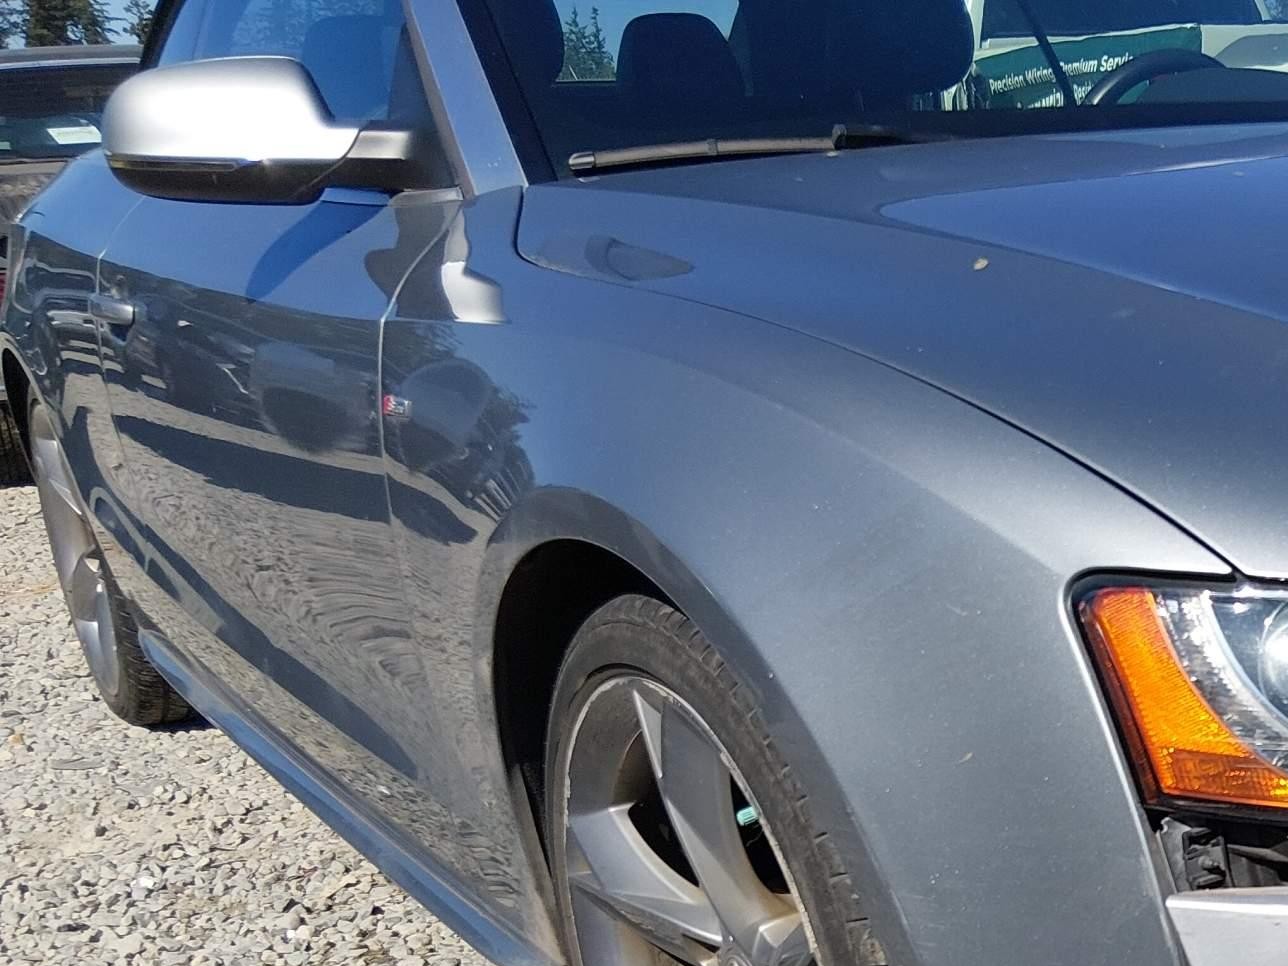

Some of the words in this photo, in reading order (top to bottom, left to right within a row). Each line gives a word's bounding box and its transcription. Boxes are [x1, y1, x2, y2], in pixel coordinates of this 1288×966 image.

[989, 72, 1027, 96] Precision
[1025, 66, 1056, 85] Wiring
[1099, 52, 1134, 72] Servi
